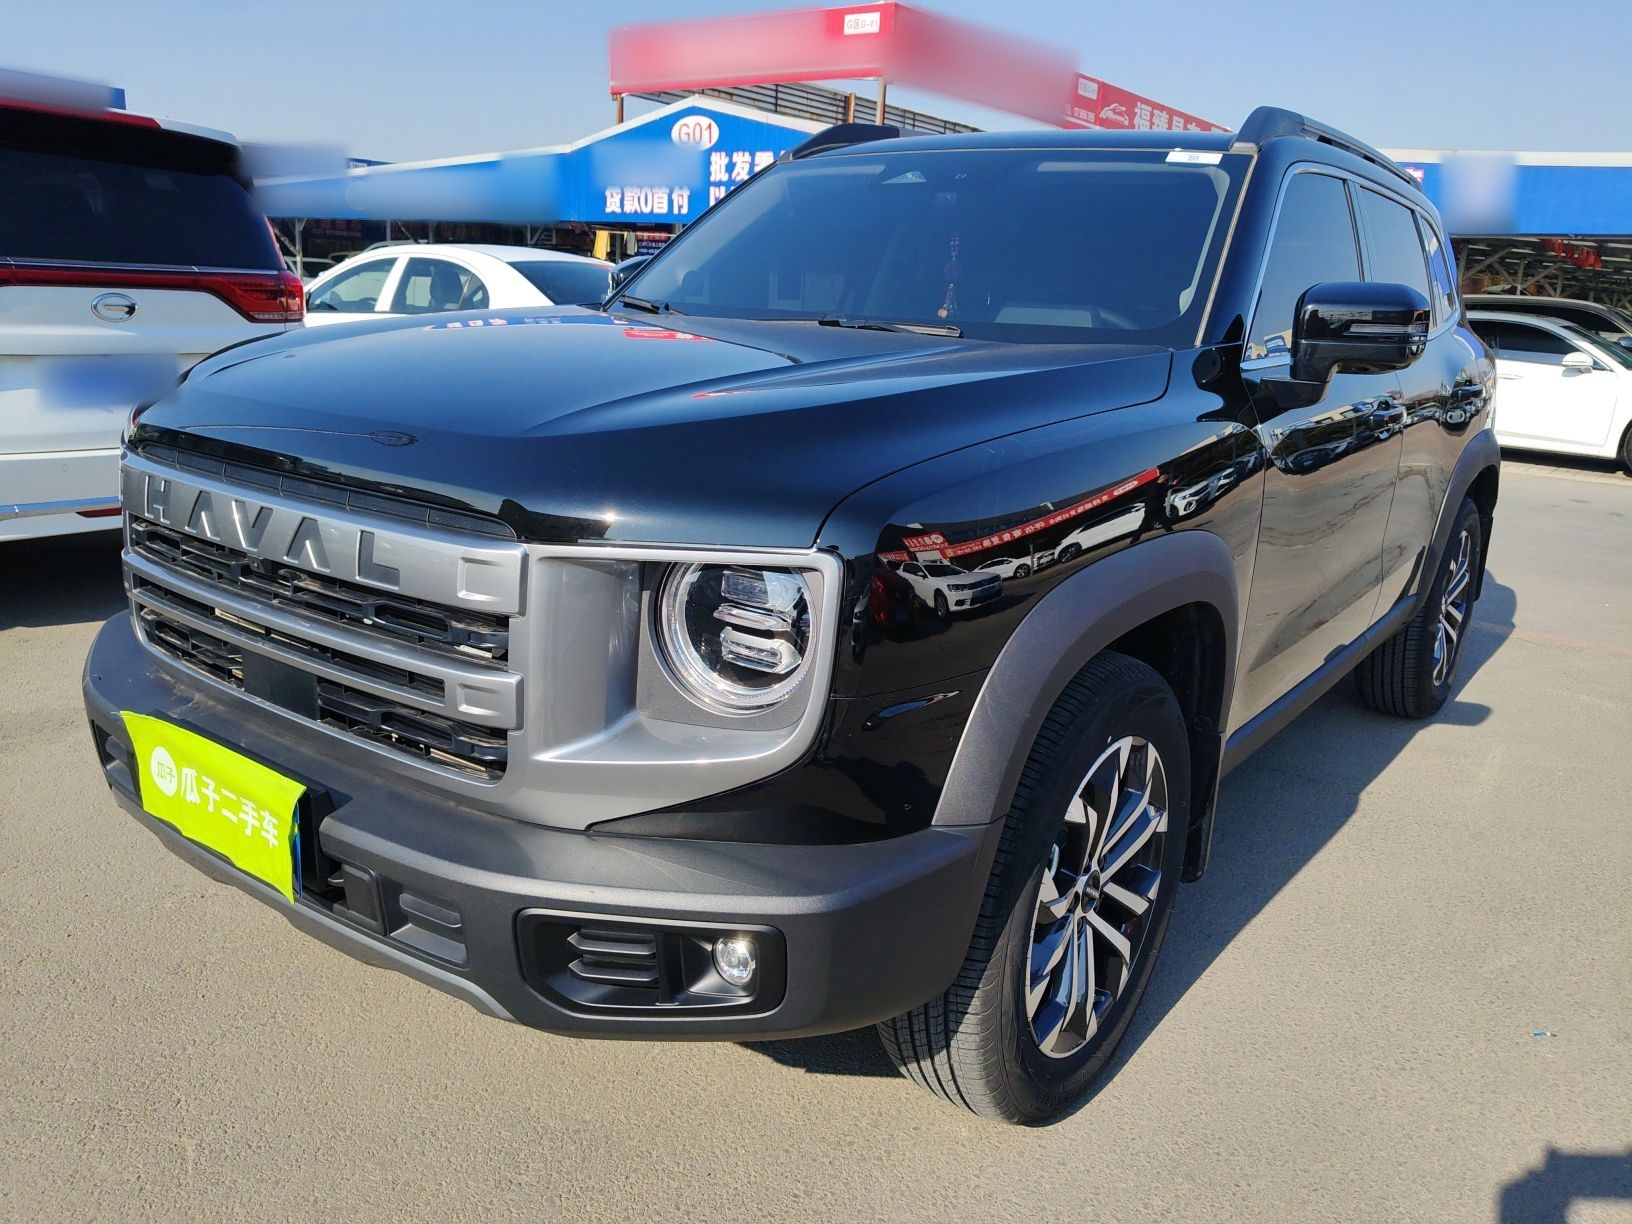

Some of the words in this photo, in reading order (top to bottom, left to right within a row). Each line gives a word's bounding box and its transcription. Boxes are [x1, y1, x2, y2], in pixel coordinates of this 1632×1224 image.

[678, 122, 712, 145] G01
[710, 151, 786, 182] 批发零
[605, 185, 690, 215] 贷款0首付
[144, 474, 401, 592] HAVAL
[180, 766, 279, 849] 瓜子二手车
